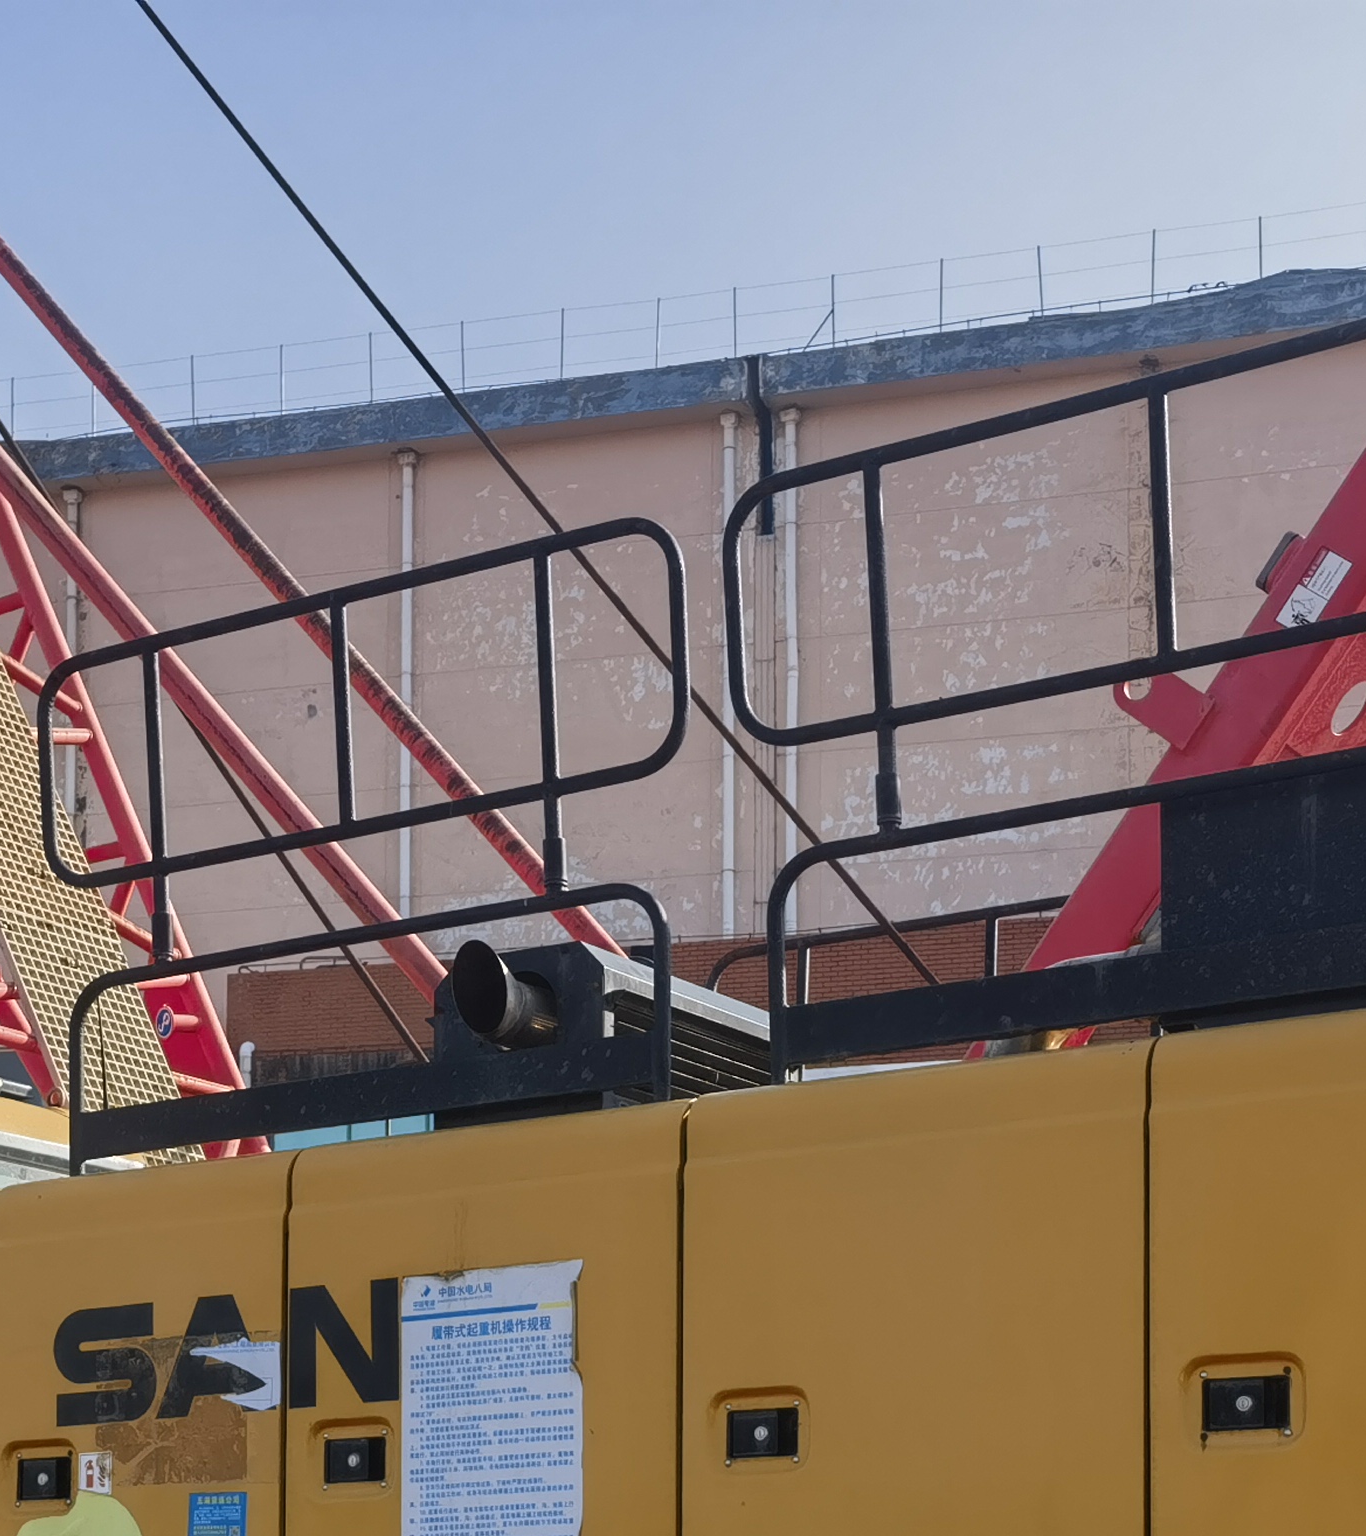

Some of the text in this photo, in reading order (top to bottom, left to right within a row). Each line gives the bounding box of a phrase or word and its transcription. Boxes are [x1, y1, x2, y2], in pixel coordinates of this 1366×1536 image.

[438, 1282, 493, 1298] 中国水电八局
[431, 1316, 552, 1340] 履带式起重机操作规程
